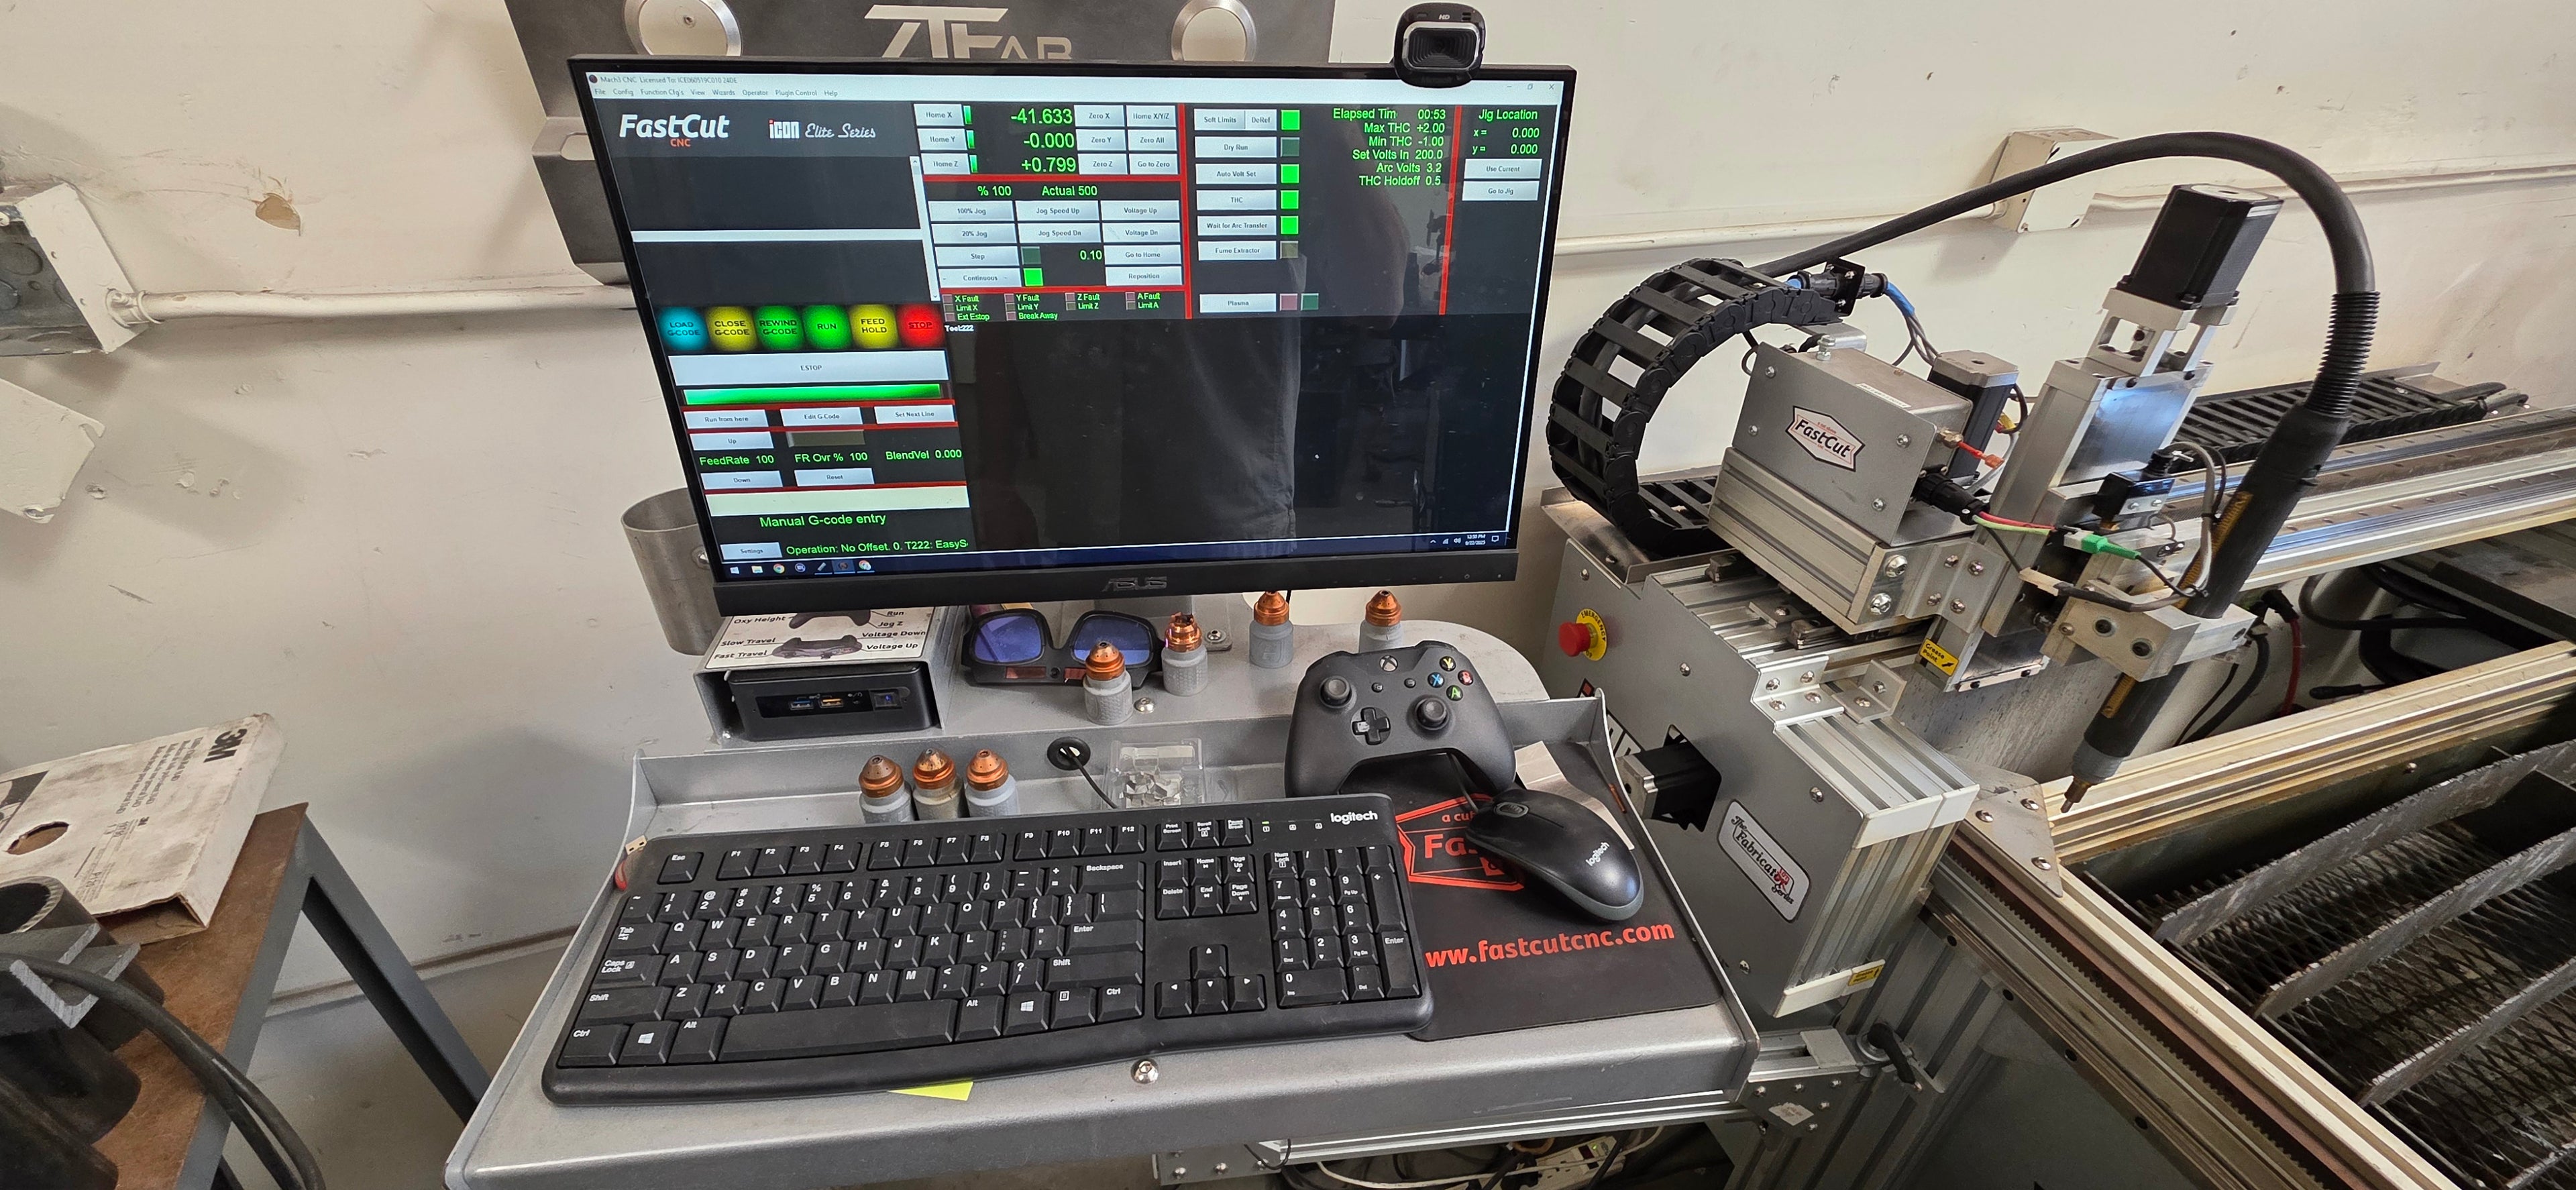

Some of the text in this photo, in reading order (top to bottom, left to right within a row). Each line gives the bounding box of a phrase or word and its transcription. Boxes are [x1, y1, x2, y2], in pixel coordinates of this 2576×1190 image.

[1011, 109, 1073, 124] -41.633
[1333, 108, 1446, 121] Elapsed Tim 00:53
[1479, 109, 1538, 121] Jig Location
[619, 114, 730, 138] FastCut
[805, 123, 835, 138] Elite
[838, 123, 876, 138] Series
[1364, 123, 1445, 133] Max THC +2.00
[1512, 128, 1540, 138] 0.000
[670, 139, 691, 147] CNC
[1024, 133, 1075, 148] -0.000
[1368, 136, 1444, 146] Min THC -1.00
[1224, 144, 1234, 152] Dry
[1511, 144, 1538, 154] 0.000
[1352, 150, 1443, 160] Set Volts In 200.0
[1022, 157, 1077, 172] +0.799
[1376, 163, 1442, 173] Arc Volts 3.2
[1359, 176, 1441, 186] THC Holdoff 0.5
[977, 186, 1012, 197] % 100
[1042, 185, 1097, 196] Actual 500
[974, 208, 986, 216] Jog
[1036, 207, 1080, 215] Jog Speed Up
[1124, 207, 1157, 215] Voltage Up
[971, 253, 985, 262] Step
[1079, 250, 1102, 261] 0.10
[1128, 272, 1161, 281] Reposition
[955, 294, 979, 303] X Fault
[1016, 294, 1040, 302] Y Fault
[861, 318, 885, 326] FEED
[1039, 312, 1059, 321] Away
[759, 319, 797, 327] REWIND
[908, 321, 933, 329] STOP
[763, 327, 798, 335] G-CODE
[861, 326, 888, 334] HOLD
[1795, 419, 1851, 457] FastCut
[699, 455, 774, 466] FeedRate 100
[795, 452, 868, 463] FR Ovr % 100
[885, 449, 962, 461] BlendVel 0.000
[759, 514, 886, 528] Manual G-code entry
[786, 545, 838, 555] Operation:
[841, 543, 855, 552] No
[904, 541, 932, 551] T222:
[1102, 576, 1167, 591] ASUS
[1581, 610, 1606, 642] EMERGENCY
[1923, 649, 1938, 663] Point
[1925, 643, 1945, 659] Grease
[1444, 659, 1452, 668] Y
[1432, 674, 1440, 686] X
[1462, 672, 1470, 683] B
[1451, 687, 1460, 698] A
[203, 728, 247, 763] 3M
[1330, 811, 1378, 825] logitech
[1442, 814, 1450, 823] a
[1731, 815, 1748, 831] The
[1585, 841, 1611, 866] logitech
[1772, 884, 1794, 904] Series
[674, 922, 684, 931] Q
[712, 920, 724, 929] W
[1385, 937, 1404, 945] Enter
